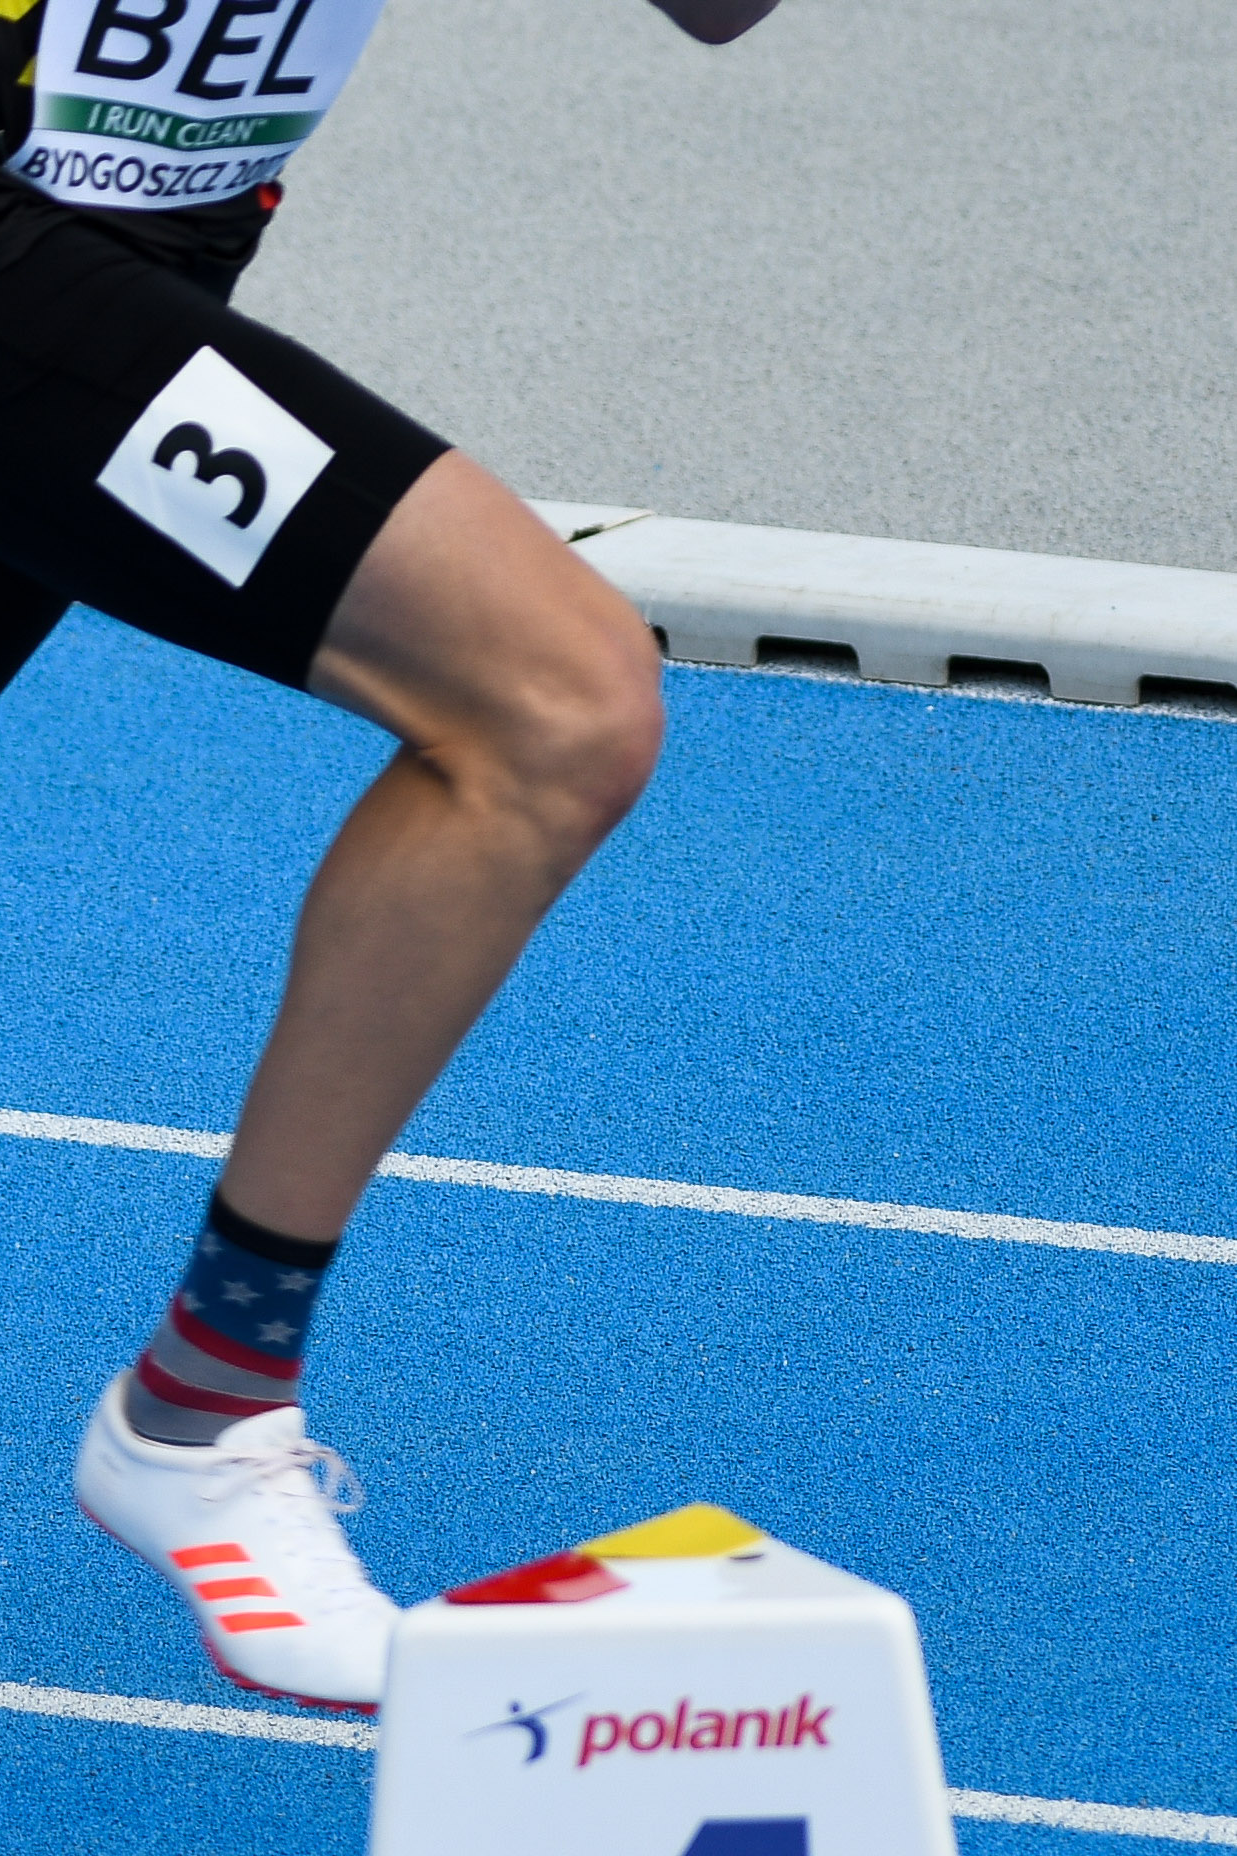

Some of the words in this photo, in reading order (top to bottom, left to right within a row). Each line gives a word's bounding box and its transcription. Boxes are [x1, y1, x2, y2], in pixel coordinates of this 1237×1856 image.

[87, 102, 103, 130] I
[103, 104, 174, 142] RUN
[20, 146, 229, 197] BYDGOSZCZ
[151, 420, 268, 530] 3
[576, 1693, 835, 1770] polanik
